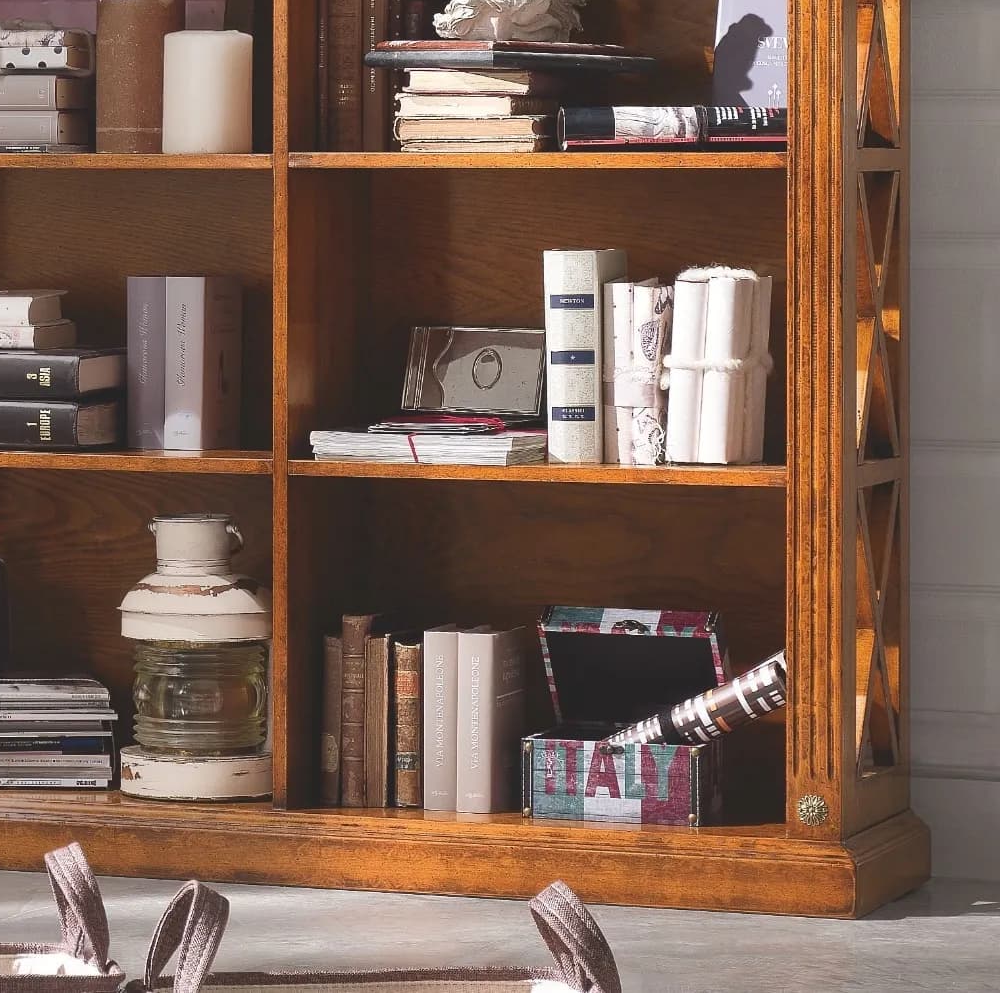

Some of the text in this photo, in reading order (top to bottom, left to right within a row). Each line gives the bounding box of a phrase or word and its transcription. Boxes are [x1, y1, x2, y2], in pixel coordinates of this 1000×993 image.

[39, 367, 51, 387] ASIA
[39, 409, 51, 441] EUROPE
[436, 750, 444, 767] VIA
[471, 752, 479, 769] VIA
[545, 741, 684, 801] ITALY
